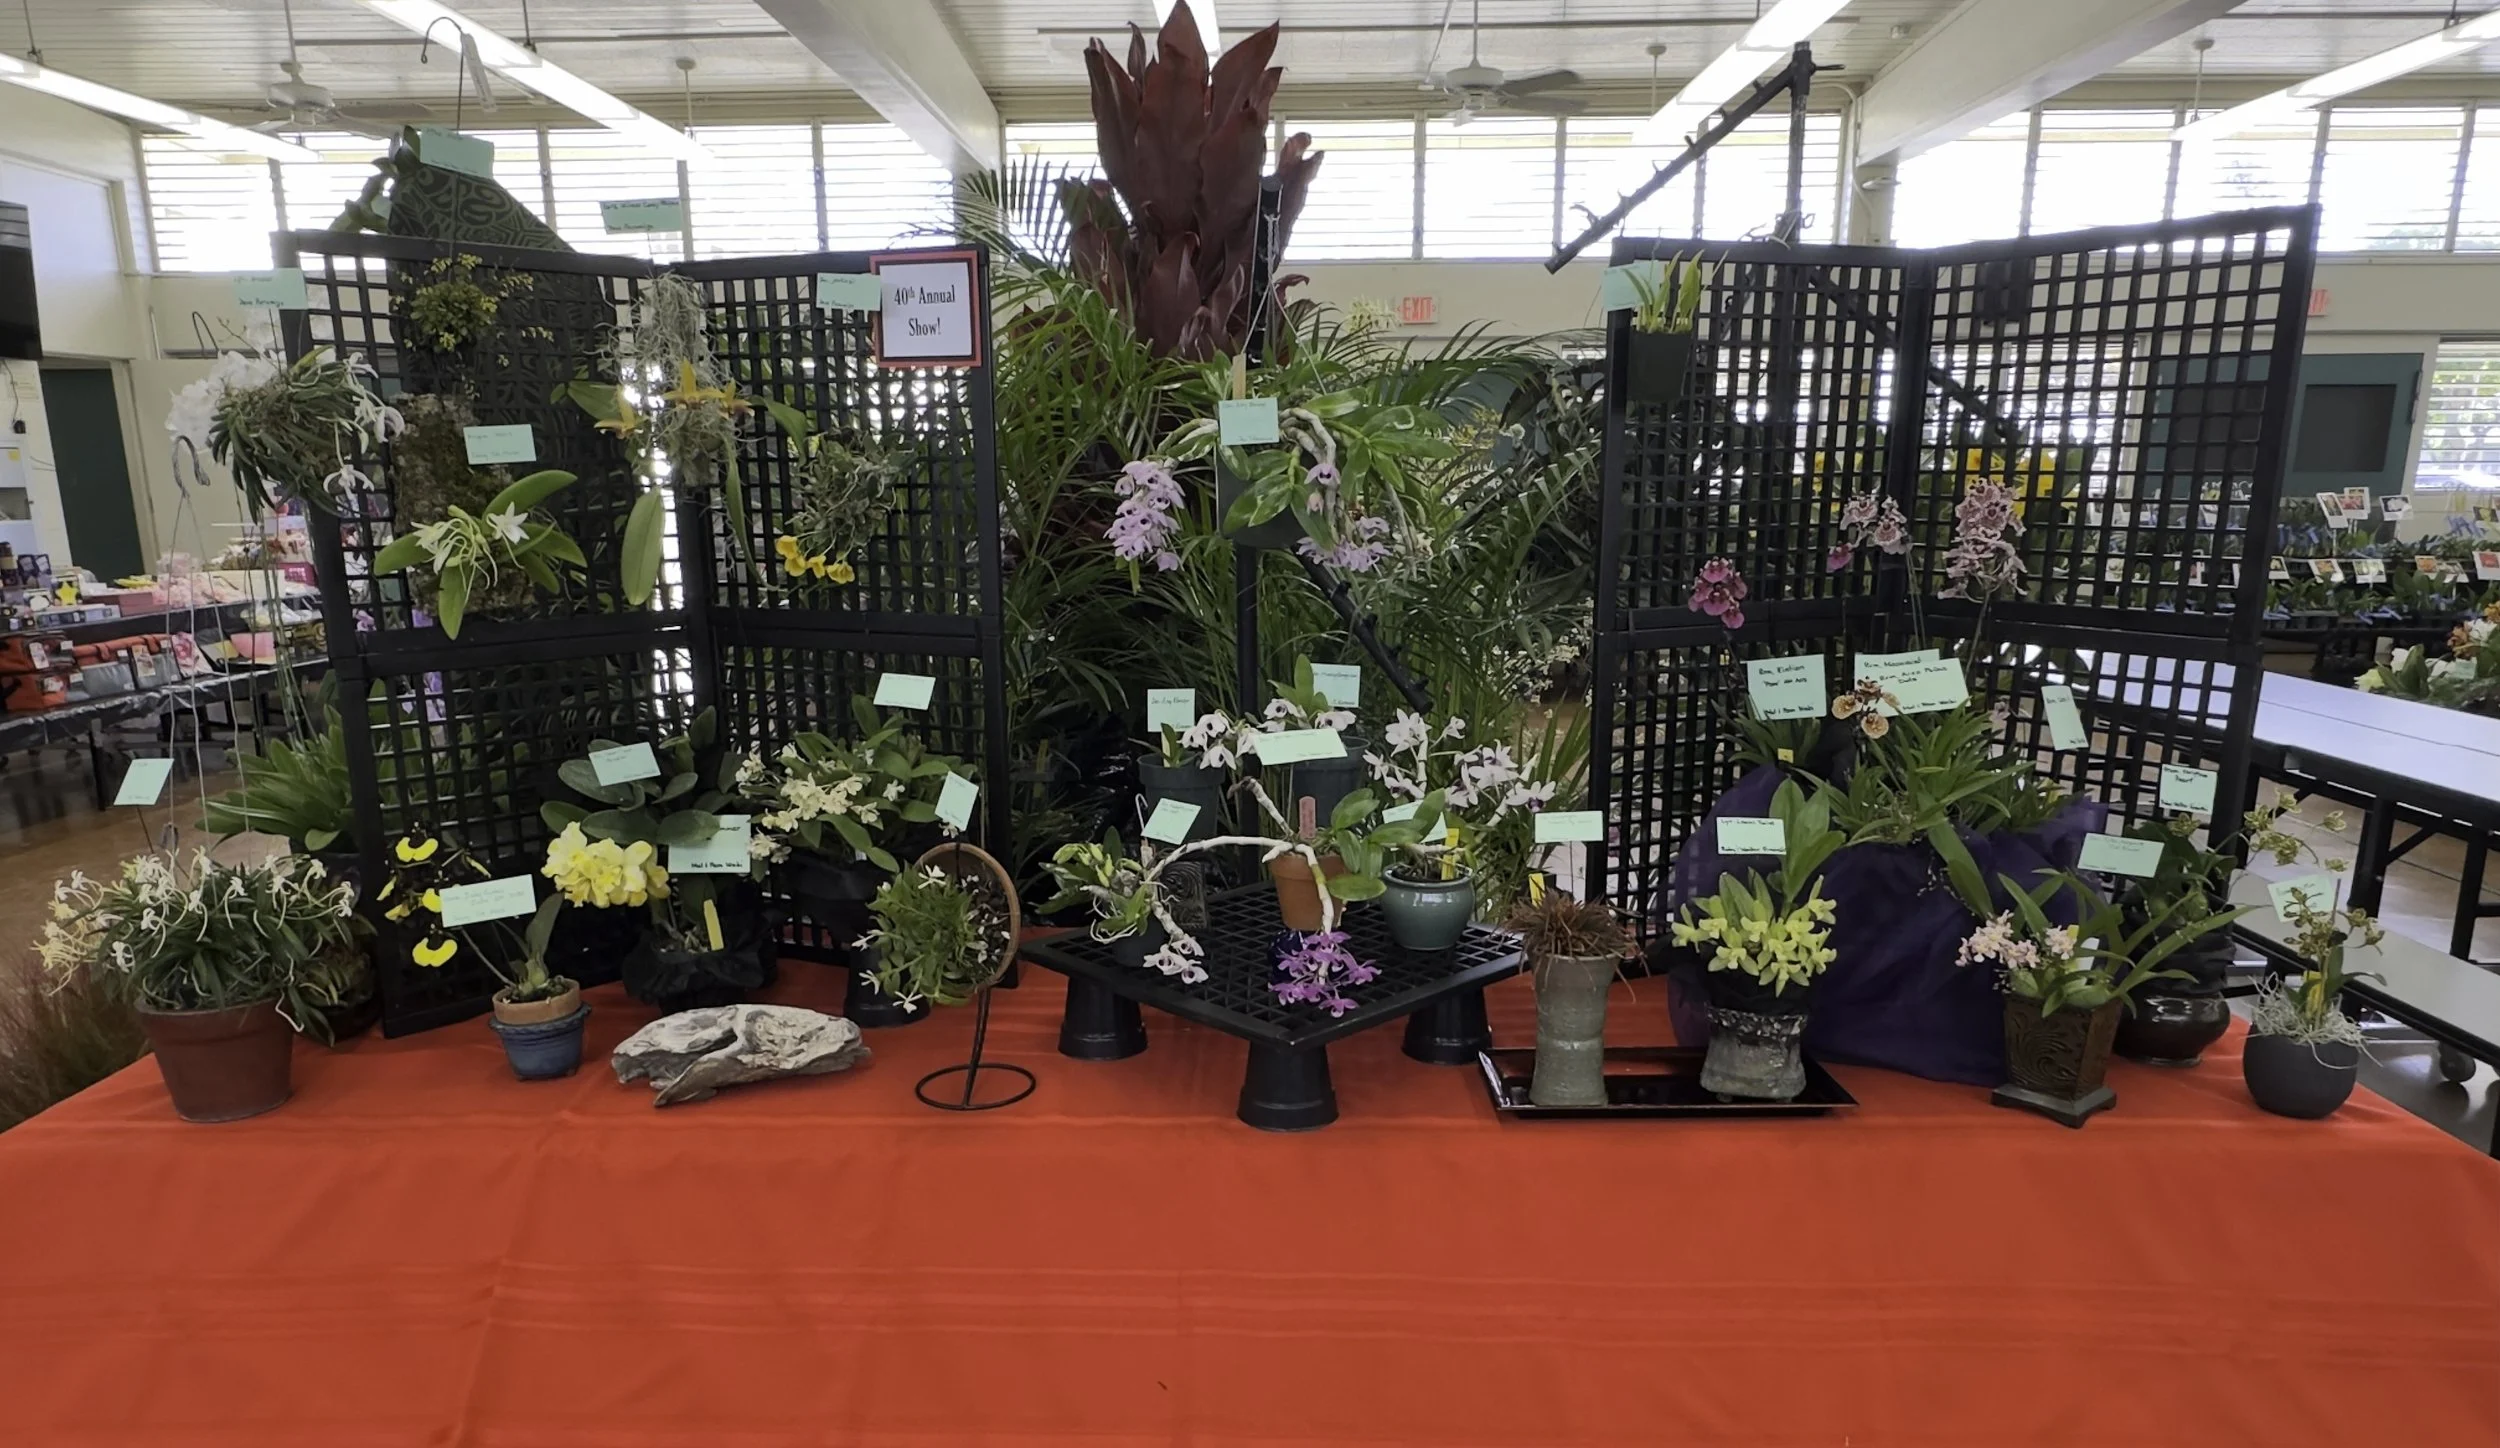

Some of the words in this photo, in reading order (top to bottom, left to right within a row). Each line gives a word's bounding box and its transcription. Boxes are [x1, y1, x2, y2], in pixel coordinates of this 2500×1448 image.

[894, 286, 916, 306] 40th
[918, 285, 956, 305] Annual
[1403, 296, 1433, 320] EXIT
[908, 317, 942, 337] Show!
